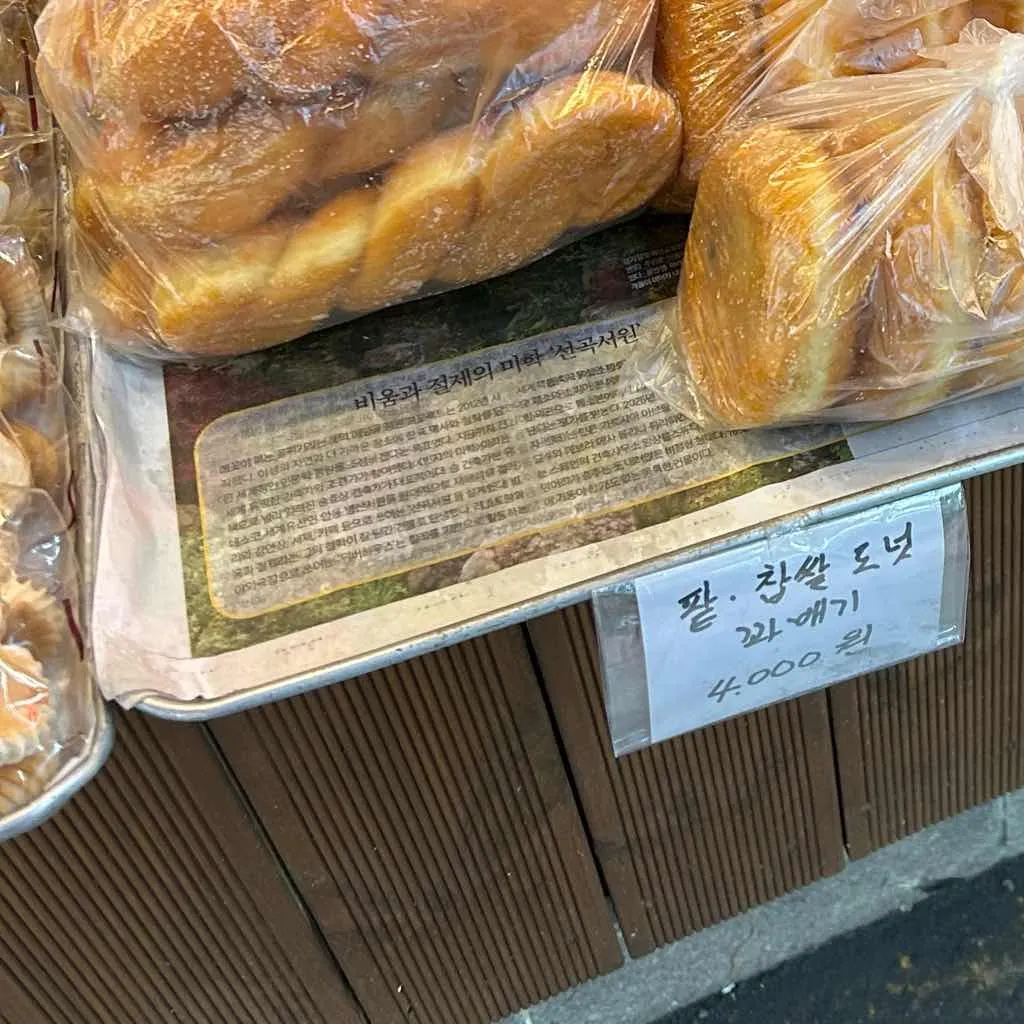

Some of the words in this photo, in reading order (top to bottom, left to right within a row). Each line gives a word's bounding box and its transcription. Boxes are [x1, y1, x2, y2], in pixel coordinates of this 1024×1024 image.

[355, 382, 422, 411] 비움과
[427, 361, 493, 396] 절제의
[500, 348, 542, 374] 미학
[851, 521, 915, 576] 도넛
[735, 589, 860, 649] 꽈배기
